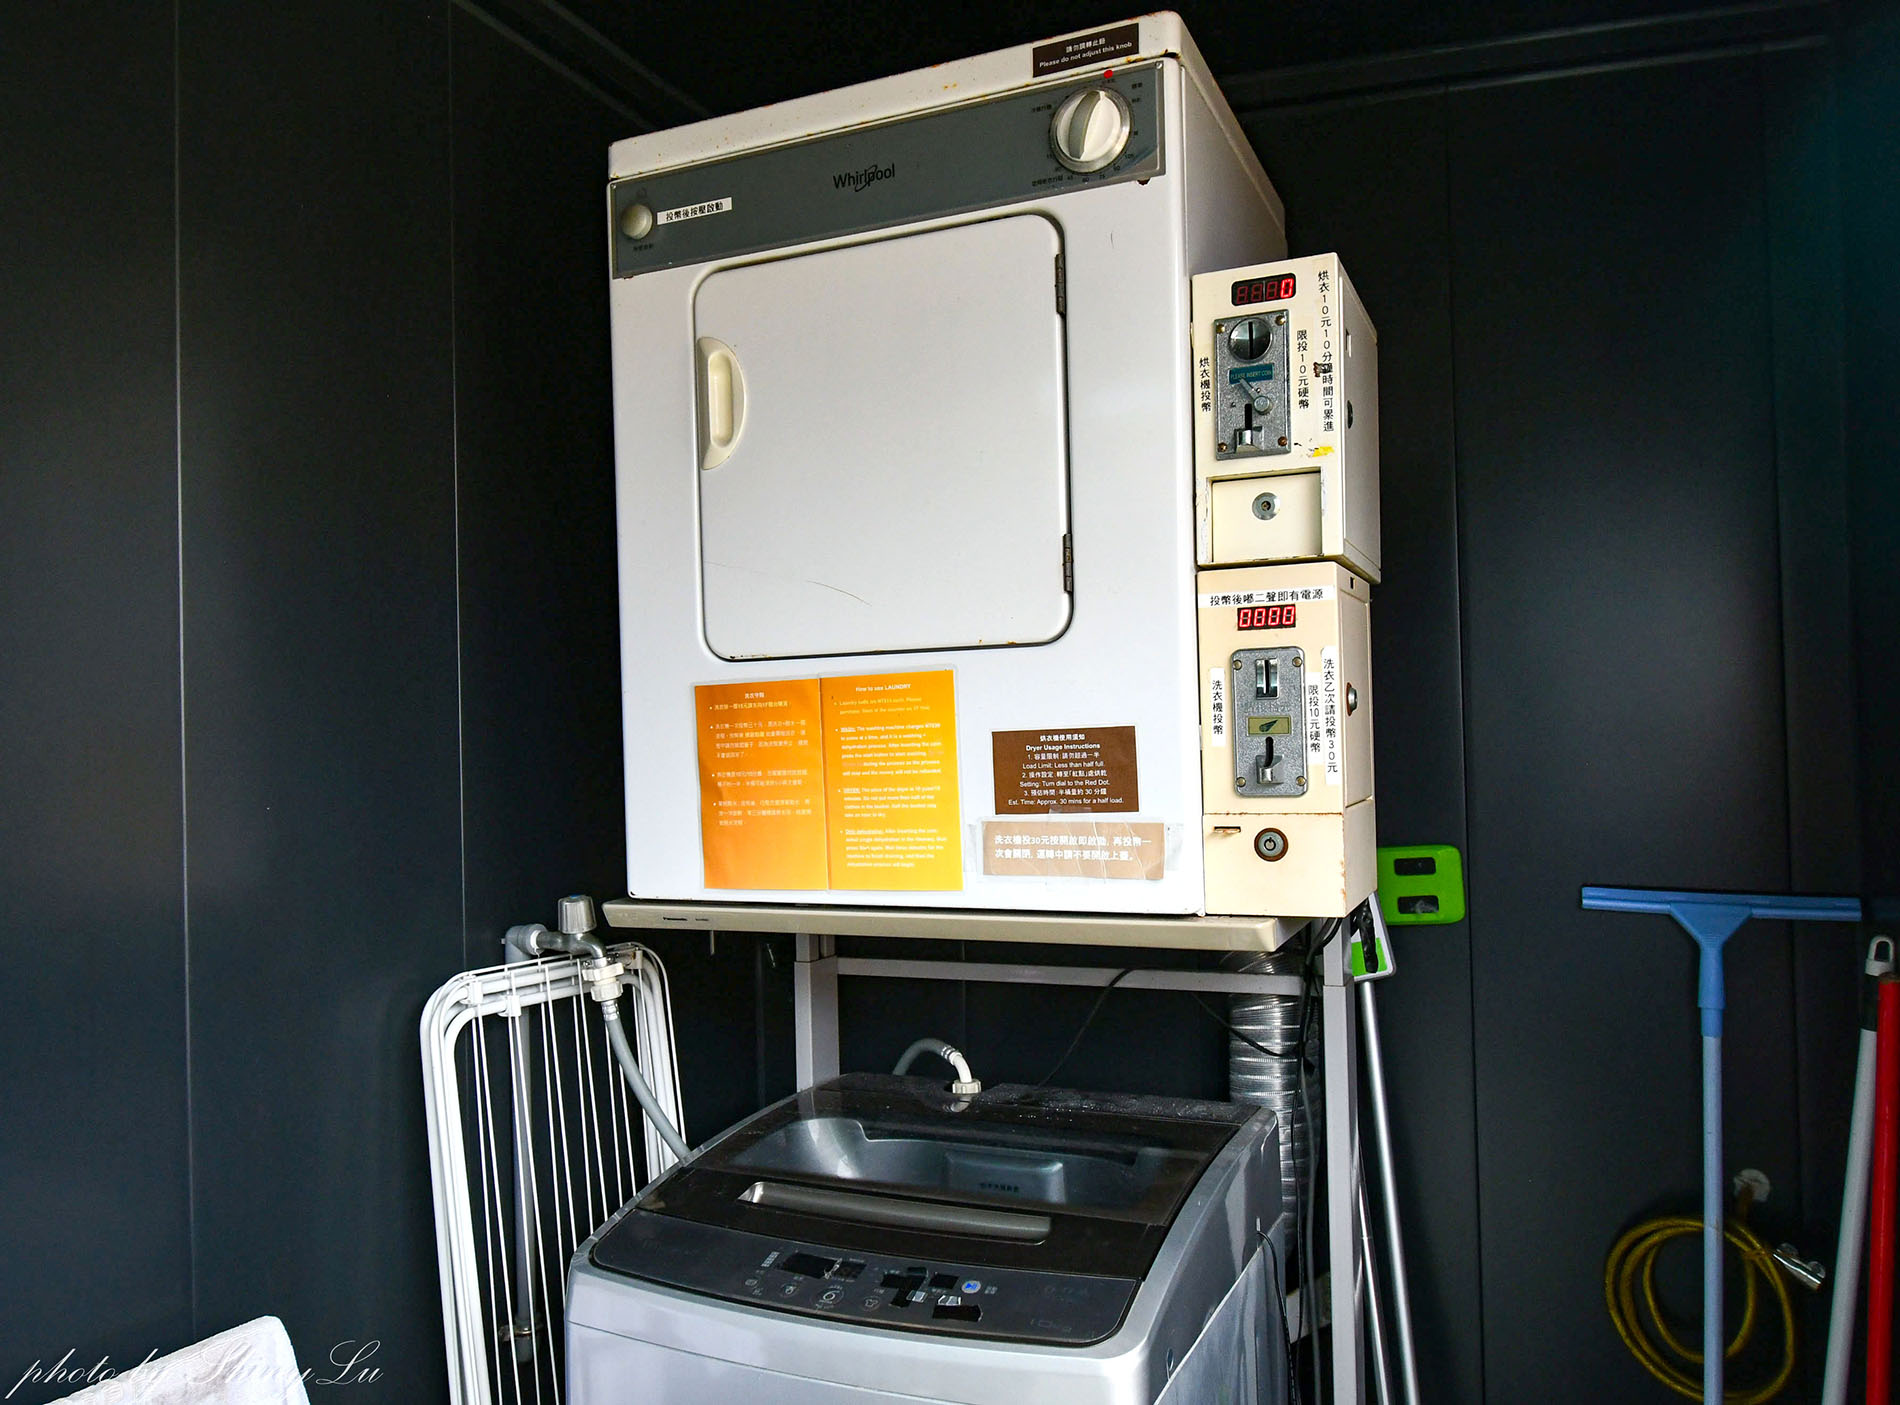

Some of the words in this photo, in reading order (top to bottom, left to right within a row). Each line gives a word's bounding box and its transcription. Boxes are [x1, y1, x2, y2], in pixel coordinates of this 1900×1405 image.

[1040, 59, 1060, 68] Please
[1082, 49, 1101, 58] adjust
[1116, 42, 1132, 50] knob
[833, 163, 894, 192] Whirlpool
[1200, 357, 1212, 412] 烘衣機投幣
[1297, 330, 1309, 409] 限投10元硬幣
[1239, 606, 1295, 628] 0000
[1212, 680, 1223, 734] 洗衣機投幣
[1308, 685, 1320, 752] 限投10元硬幣
[1324, 658, 1338, 772] 洗衣乙次請投幣30元
